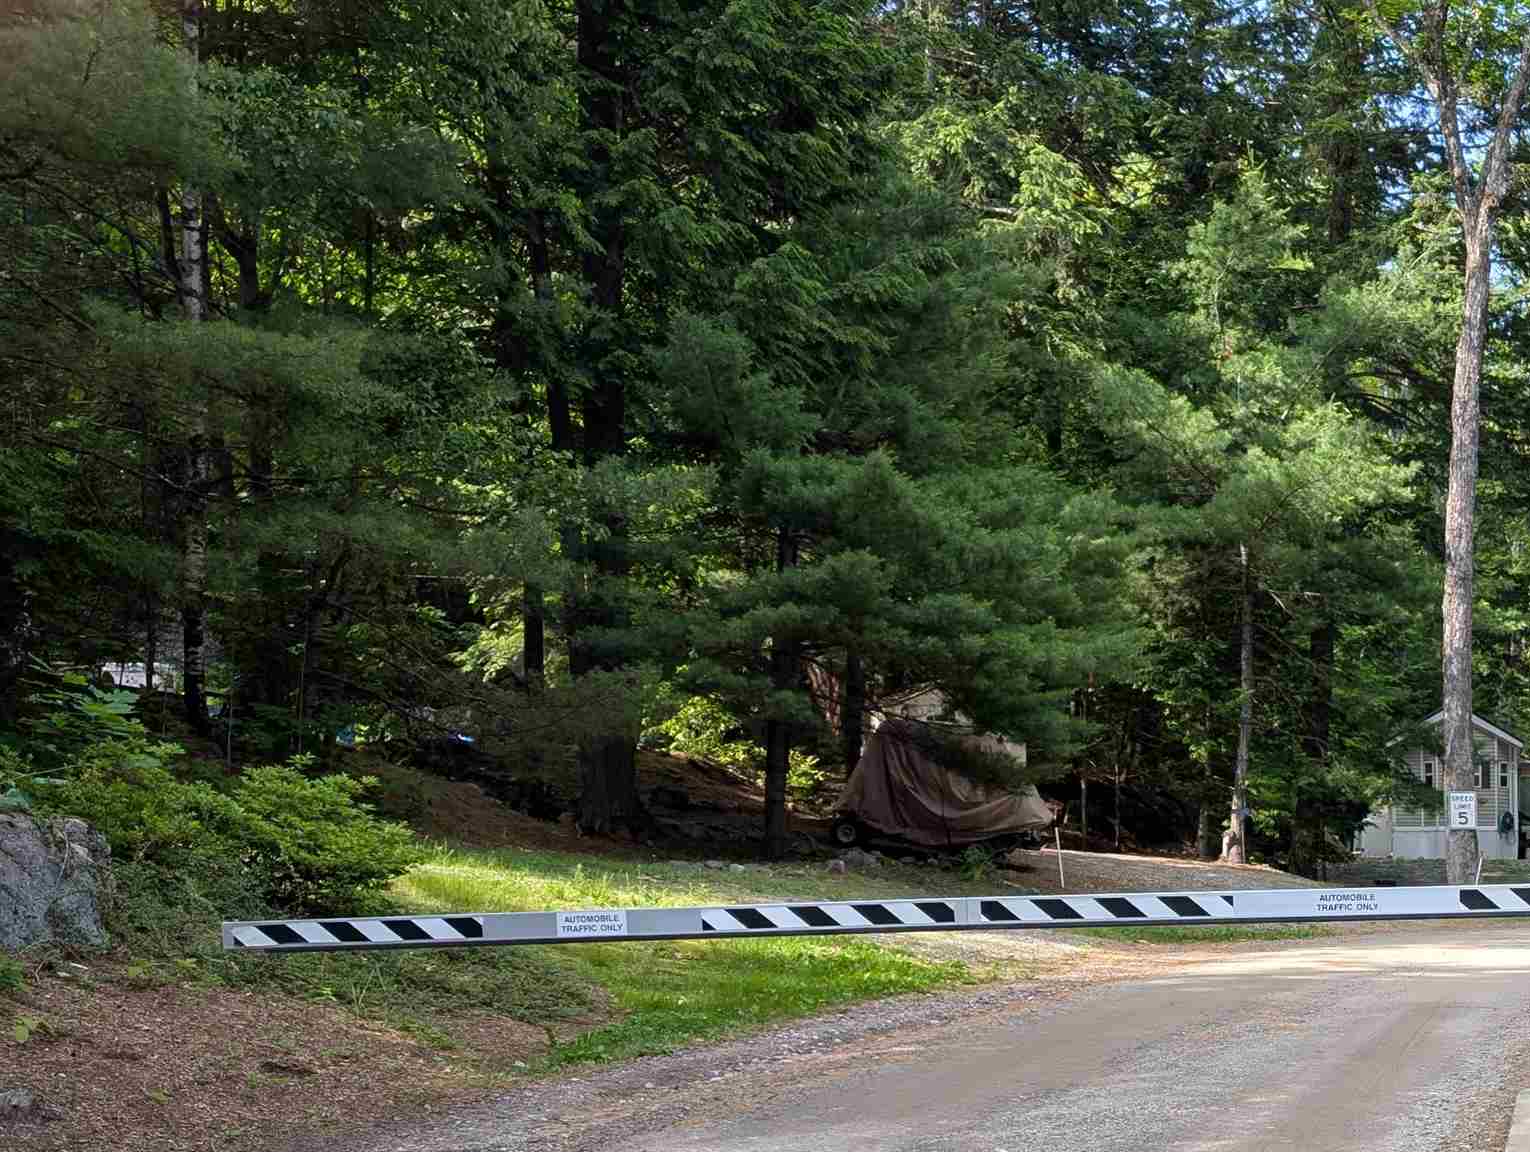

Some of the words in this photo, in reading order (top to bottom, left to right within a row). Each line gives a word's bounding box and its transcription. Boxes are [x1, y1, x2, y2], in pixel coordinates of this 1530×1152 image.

[1458, 811, 1469, 825] 5
[1320, 893, 1377, 901] AUTOMOBILE
[1317, 903, 1353, 911] TRAFFIC
[1356, 903, 1378, 911] ONLY
[564, 914, 620, 922] AUTOMOBILE
[560, 924, 598, 932] TRAFFIC
[600, 923, 624, 932] ONLY
